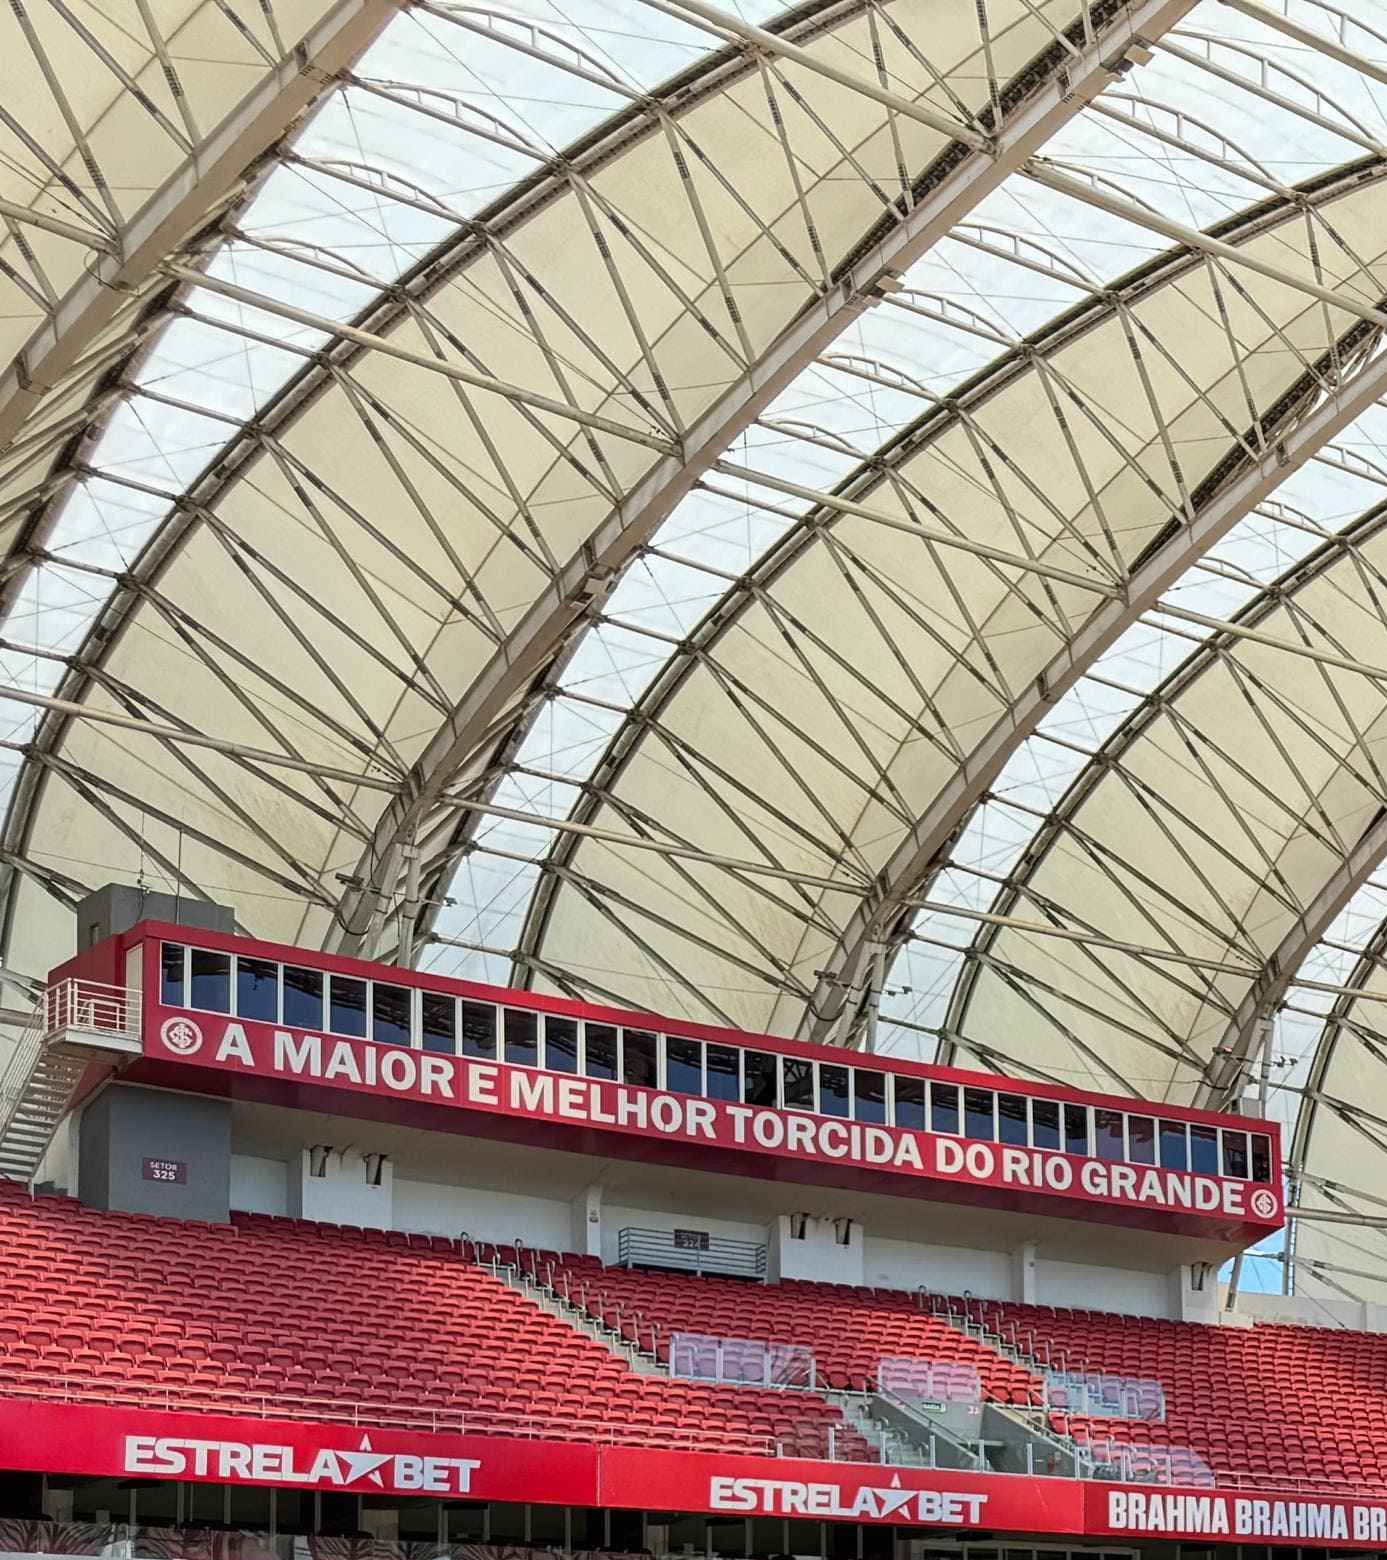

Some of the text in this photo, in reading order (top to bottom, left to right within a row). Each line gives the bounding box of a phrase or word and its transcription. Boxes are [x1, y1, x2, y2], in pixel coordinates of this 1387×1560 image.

[216, 1024, 1245, 1216] A MAIOR E MELHOR TORCIDA DO RIO GRANDE
[150, 1161, 178, 1171] SETOR
[153, 1170, 176, 1181] 325
[124, 1435, 481, 1494] ESTRELA BET
[709, 1477, 988, 1524] ESTRELA BET
[1109, 1492, 1230, 1533] BRAHMA
[1236, 1499, 1349, 1540] BRAHMA
